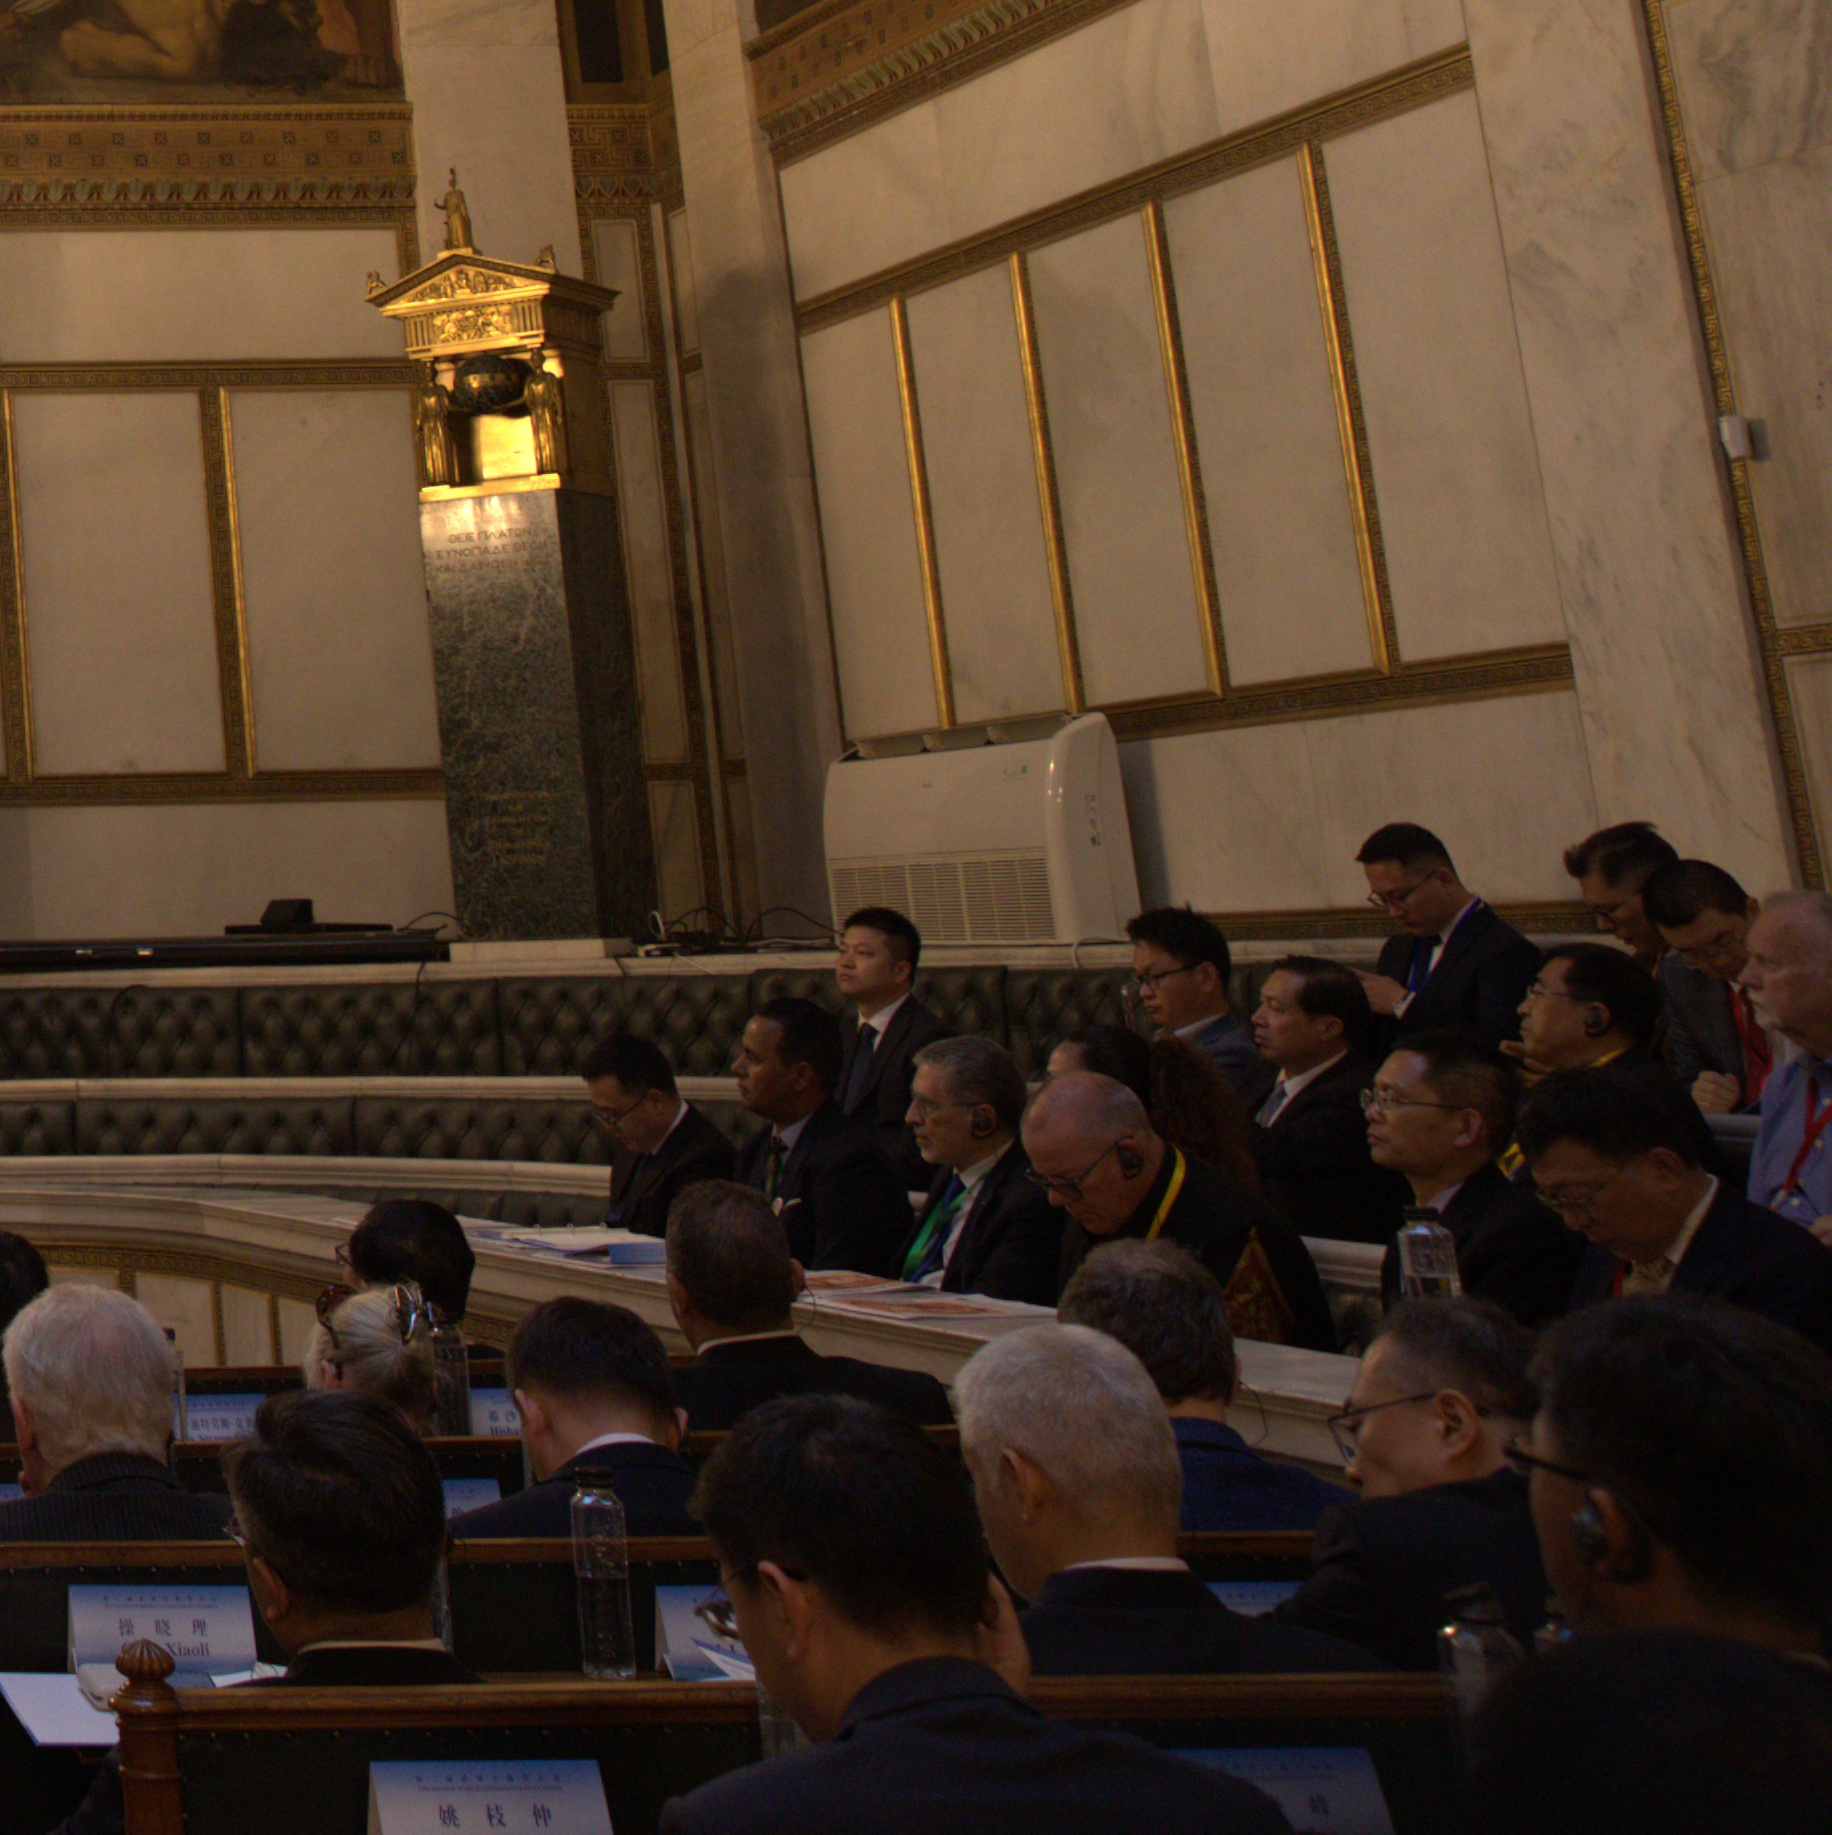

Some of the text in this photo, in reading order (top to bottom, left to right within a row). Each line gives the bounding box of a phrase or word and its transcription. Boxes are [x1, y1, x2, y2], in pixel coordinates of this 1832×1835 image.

[448, 527, 532, 544] ΘΕΙΕ ΠΛΑΤΩΝ
[165, 1642, 211, 1657] Xiaoli
